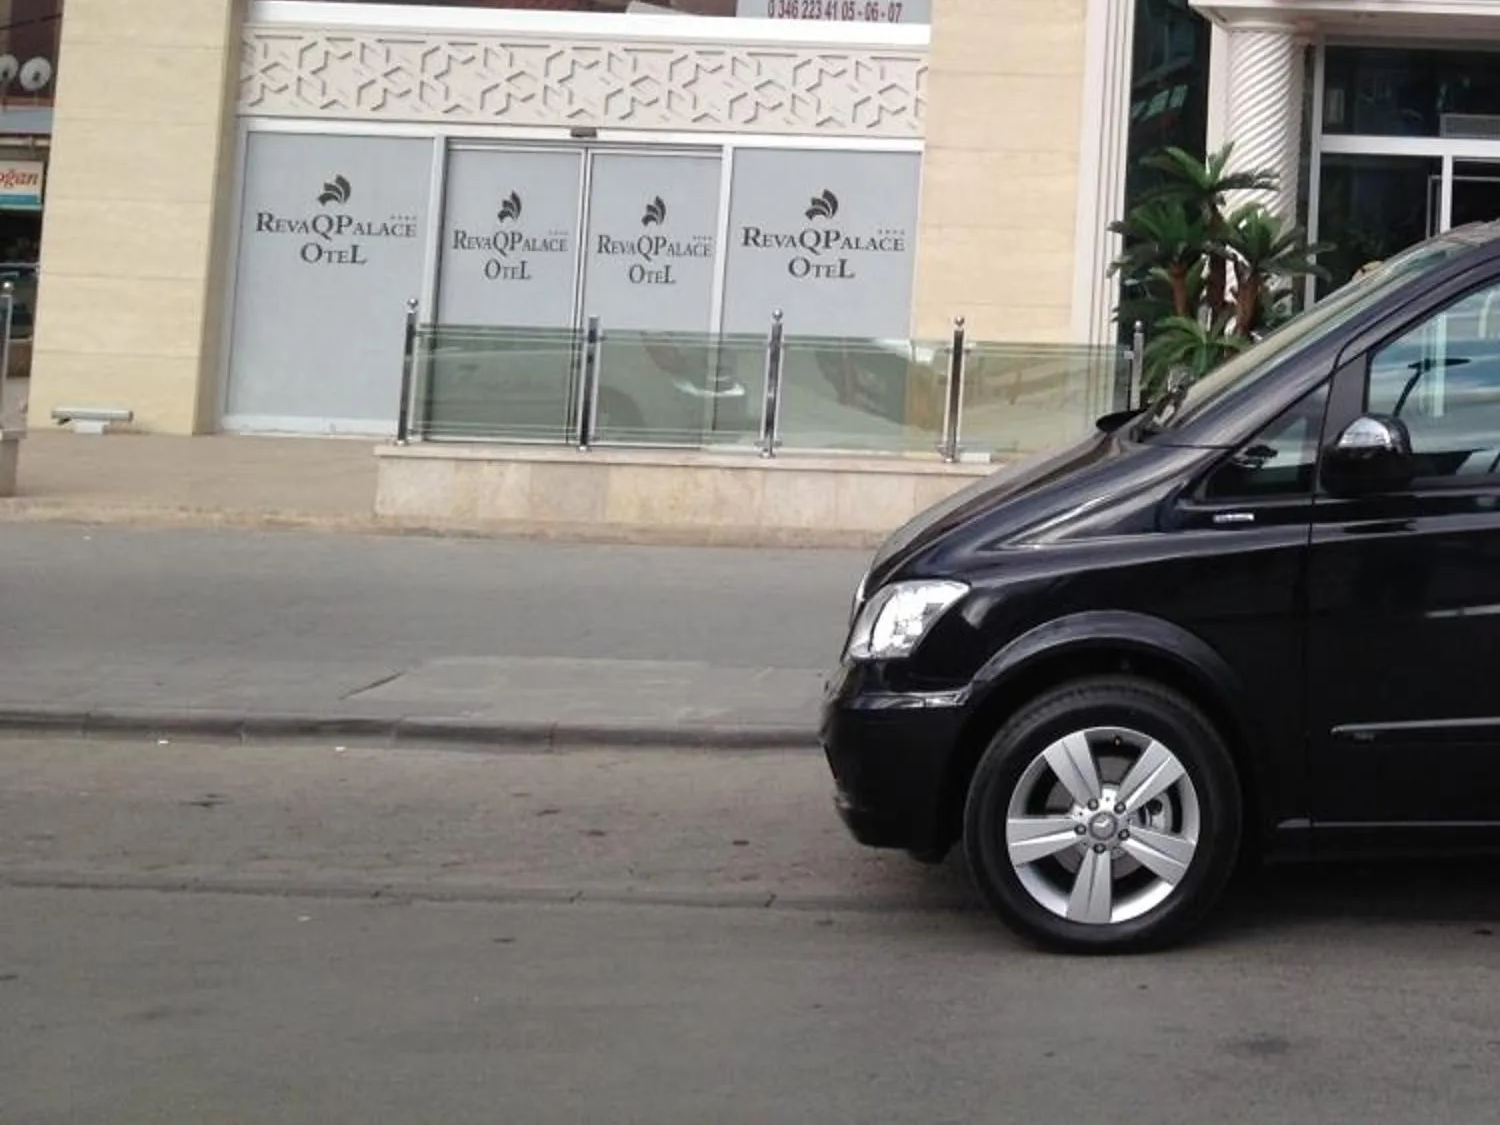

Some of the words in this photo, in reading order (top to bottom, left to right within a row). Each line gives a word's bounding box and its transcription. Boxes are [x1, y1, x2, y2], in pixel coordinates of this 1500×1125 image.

[825, 0, 837, 20] 41
[841, 0, 855, 20] 05
[864, 1, 879, 21] 06
[888, 1, 903, 23] 07
